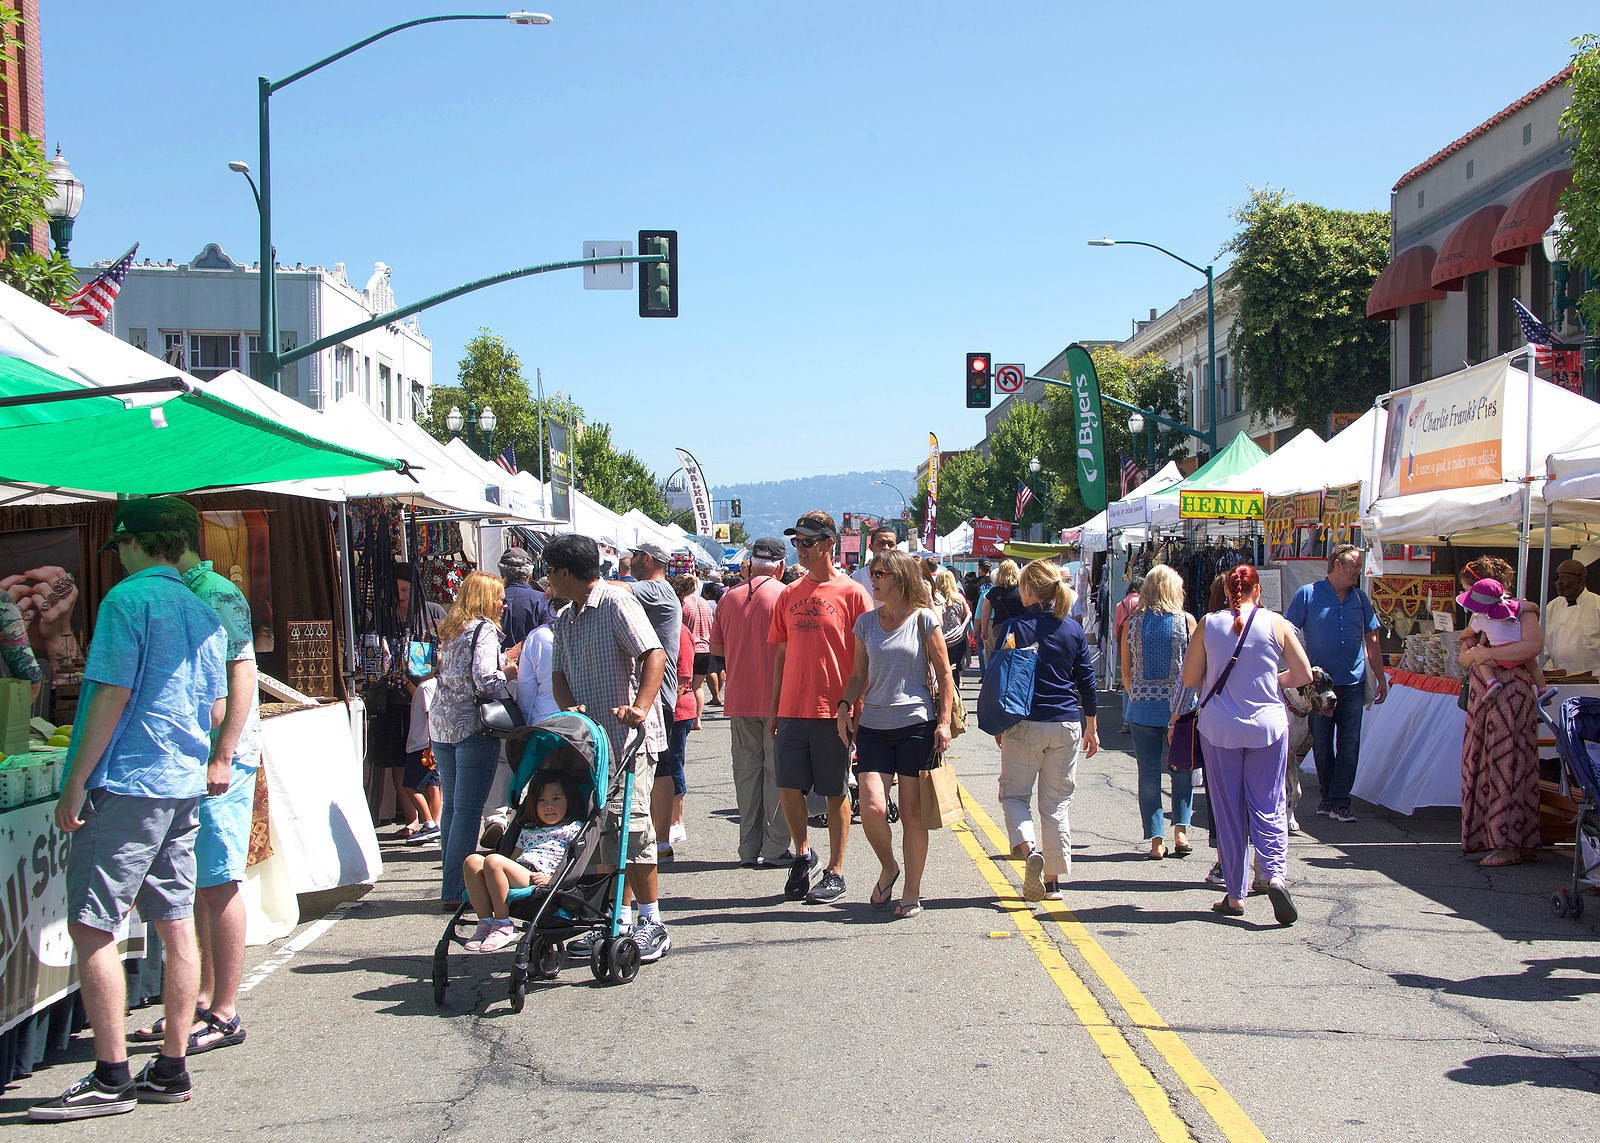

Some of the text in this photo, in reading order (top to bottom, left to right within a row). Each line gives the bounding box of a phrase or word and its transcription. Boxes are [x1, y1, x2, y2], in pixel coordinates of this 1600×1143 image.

[1076, 373, 1099, 445] Byers
[1422, 396, 1497, 433] Charlie Frank's Pies
[1451, 454, 1467, 469] makes
[1467, 456, 1477, 472] you
[1477, 449, 1497, 465] selfish!
[685, 467, 709, 534] WALKABOUT
[1181, 495, 1263, 515] HENNA
[975, 522, 993, 530] More
[789, 597, 809, 614] STAY
[622, 784, 633, 857] LITEWAY
